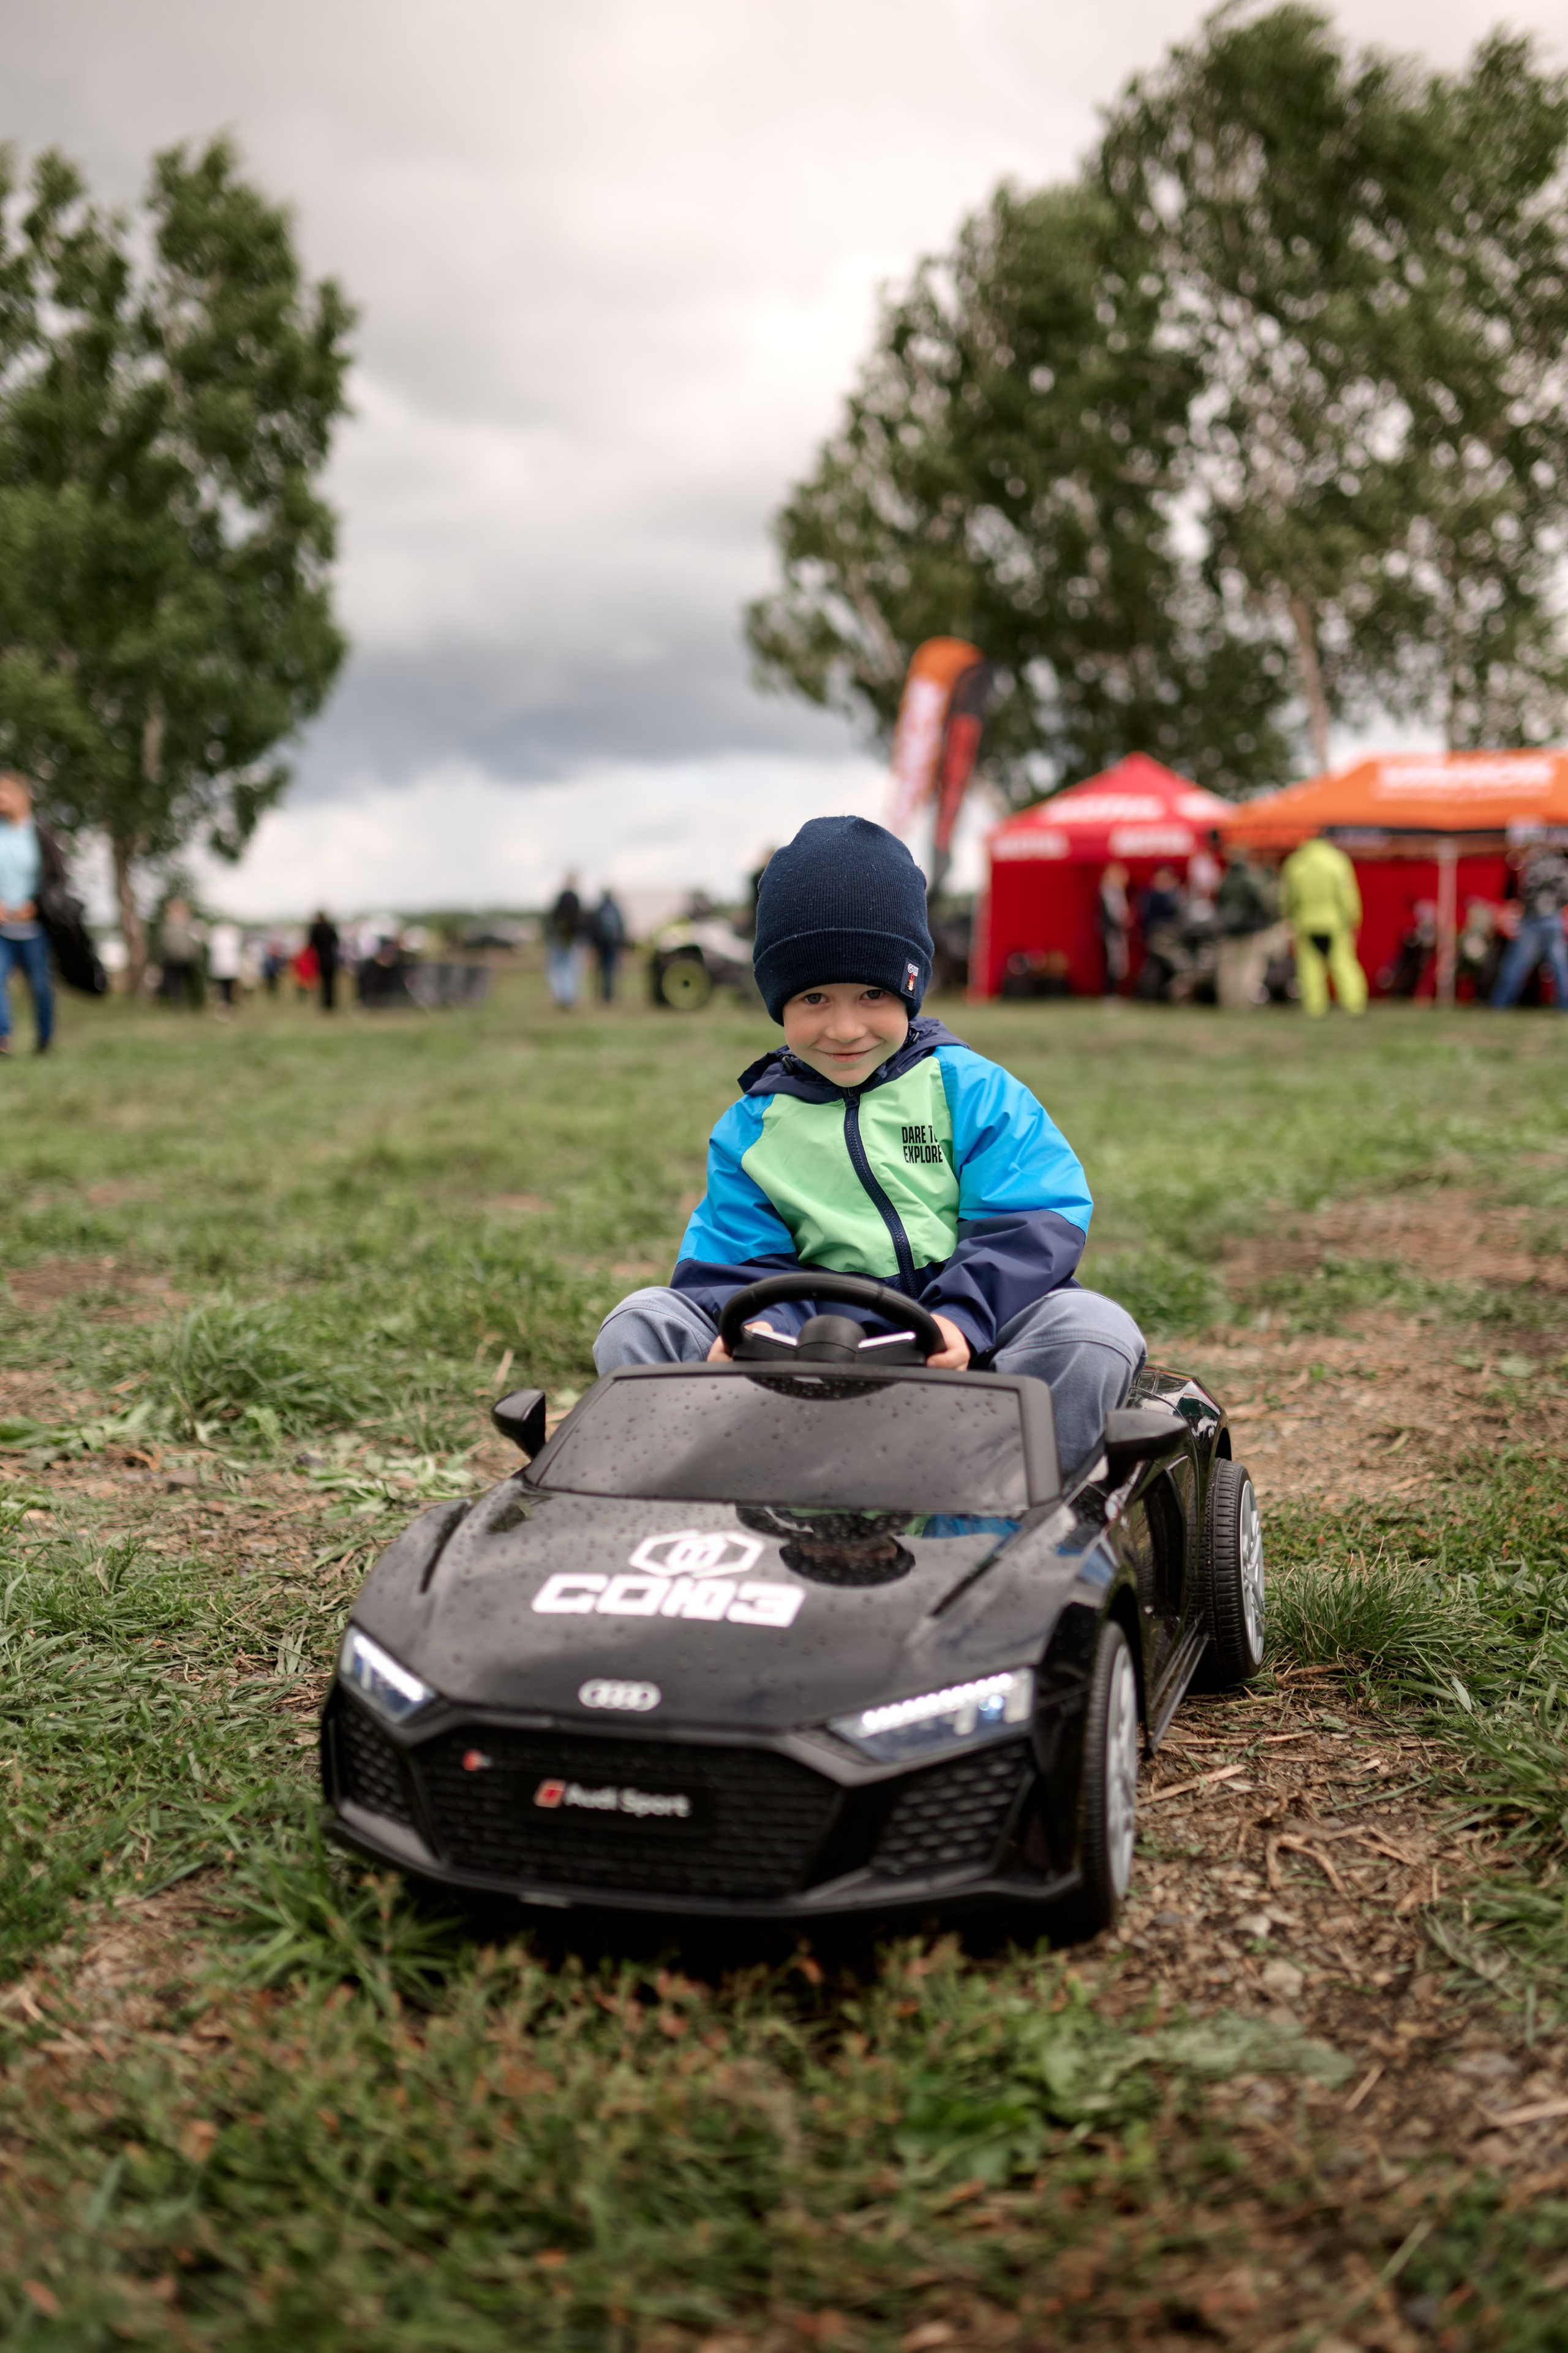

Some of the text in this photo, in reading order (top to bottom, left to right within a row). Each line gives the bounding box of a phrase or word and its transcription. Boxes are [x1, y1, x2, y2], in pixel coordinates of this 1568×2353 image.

[902, 1125, 926, 1144] DARE
[903, 1145, 943, 1163] EXPLORE
[564, 1782, 691, 1818] Audi Sport
